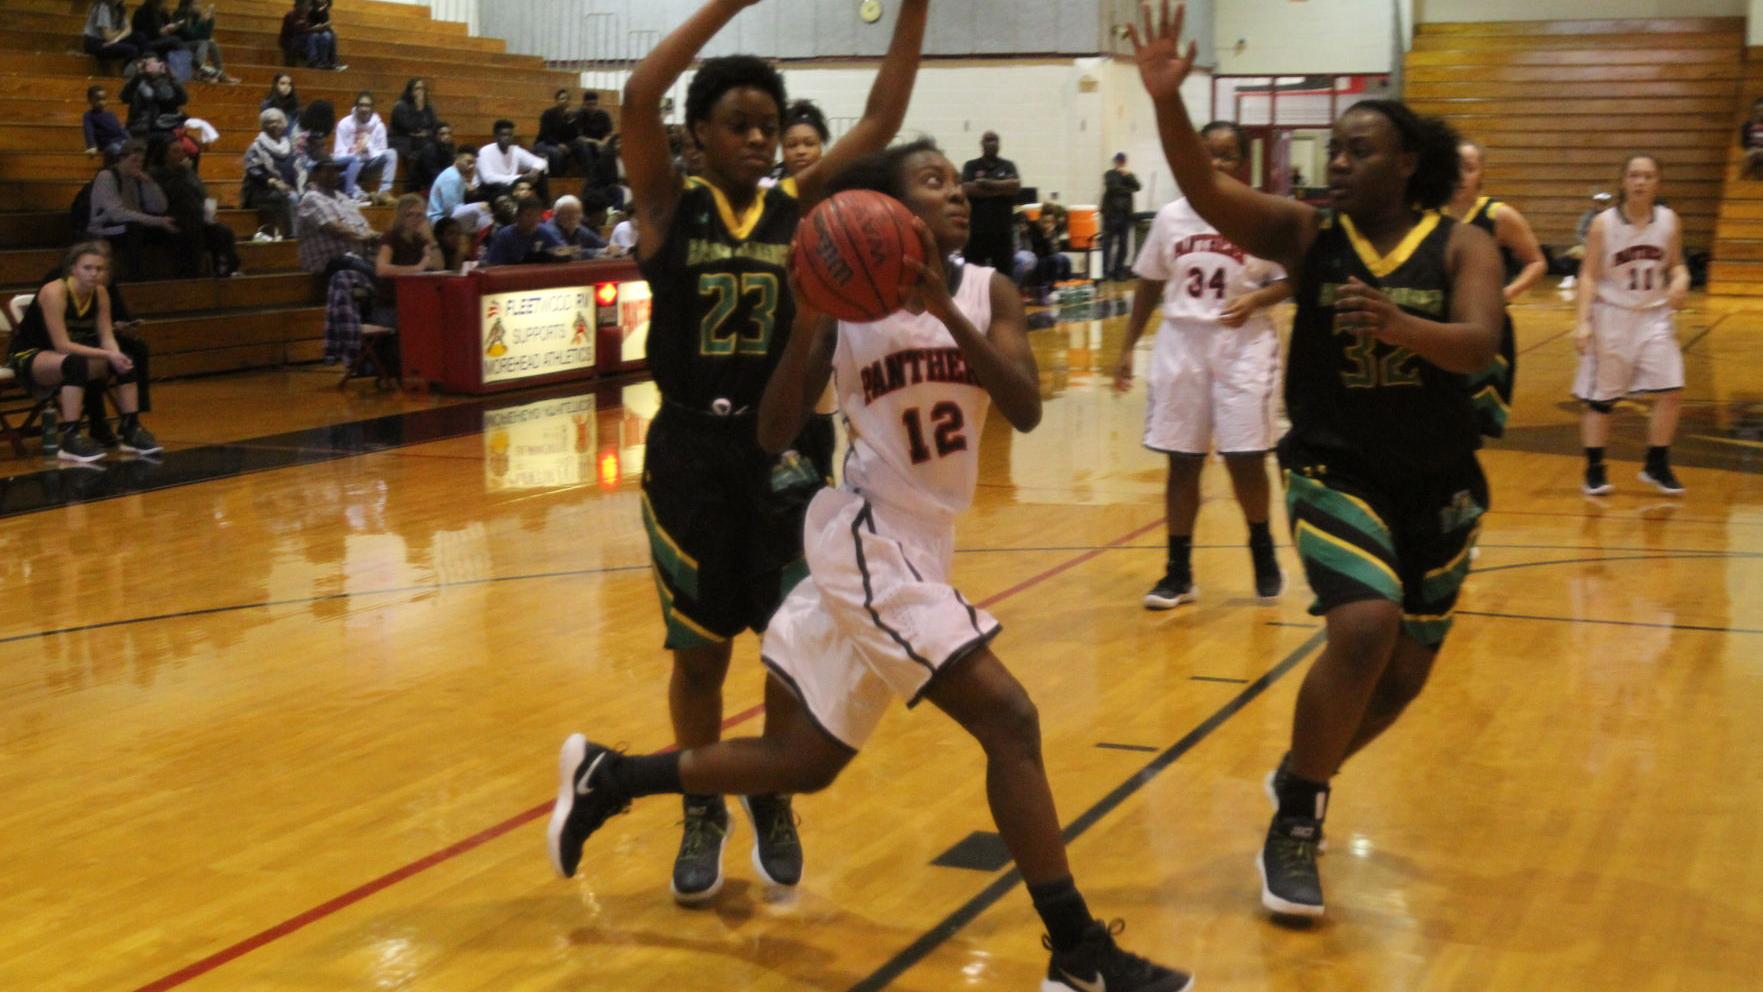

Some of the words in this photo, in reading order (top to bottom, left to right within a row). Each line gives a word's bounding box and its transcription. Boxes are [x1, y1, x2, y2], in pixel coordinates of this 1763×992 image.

[1188, 266, 1226, 299] 34
[1629, 268, 1654, 291] 11
[698, 272, 780, 355] 23
[512, 323, 566, 345] SUPPORTS
[484, 353, 540, 376] MOREHEAD
[543, 346, 593, 367] ATHLETICS
[902, 401, 968, 466] 12
